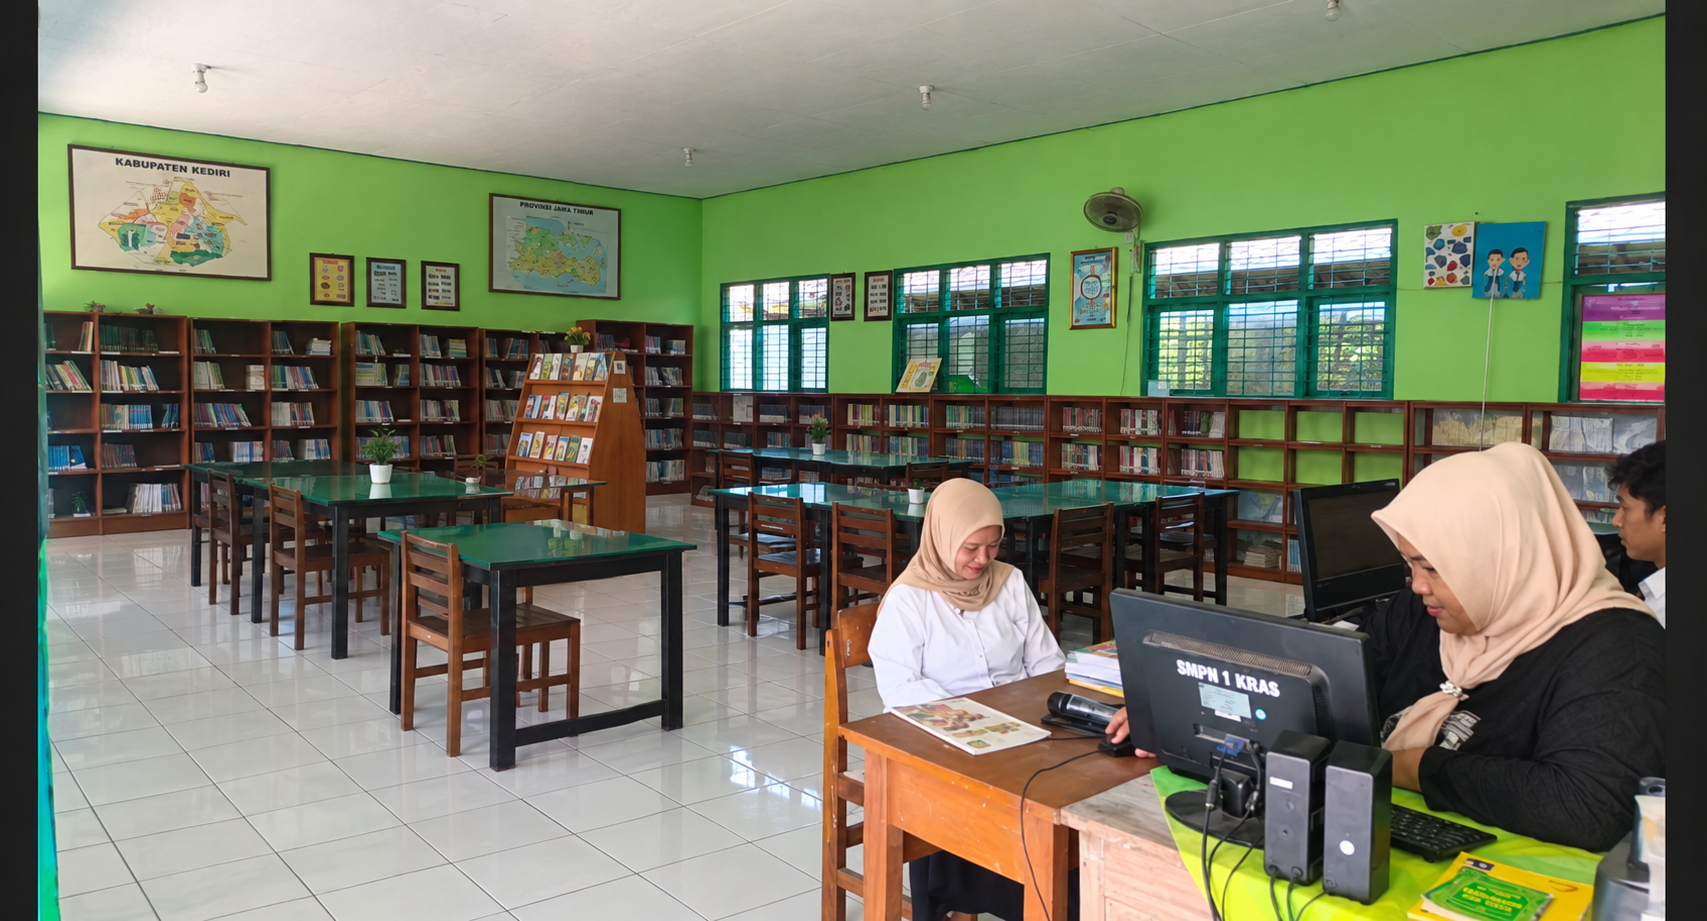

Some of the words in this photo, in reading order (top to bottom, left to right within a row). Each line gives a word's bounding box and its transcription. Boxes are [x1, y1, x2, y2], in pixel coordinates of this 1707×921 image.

[115, 158, 187, 173] KABUPATEN
[192, 167, 230, 177] KEDIRI
[520, 202, 552, 210] PROVINSI
[1177, 660, 1218, 684] SMPN
[1221, 670, 1231, 686] 1
[1235, 673, 1280, 697] KRAS
